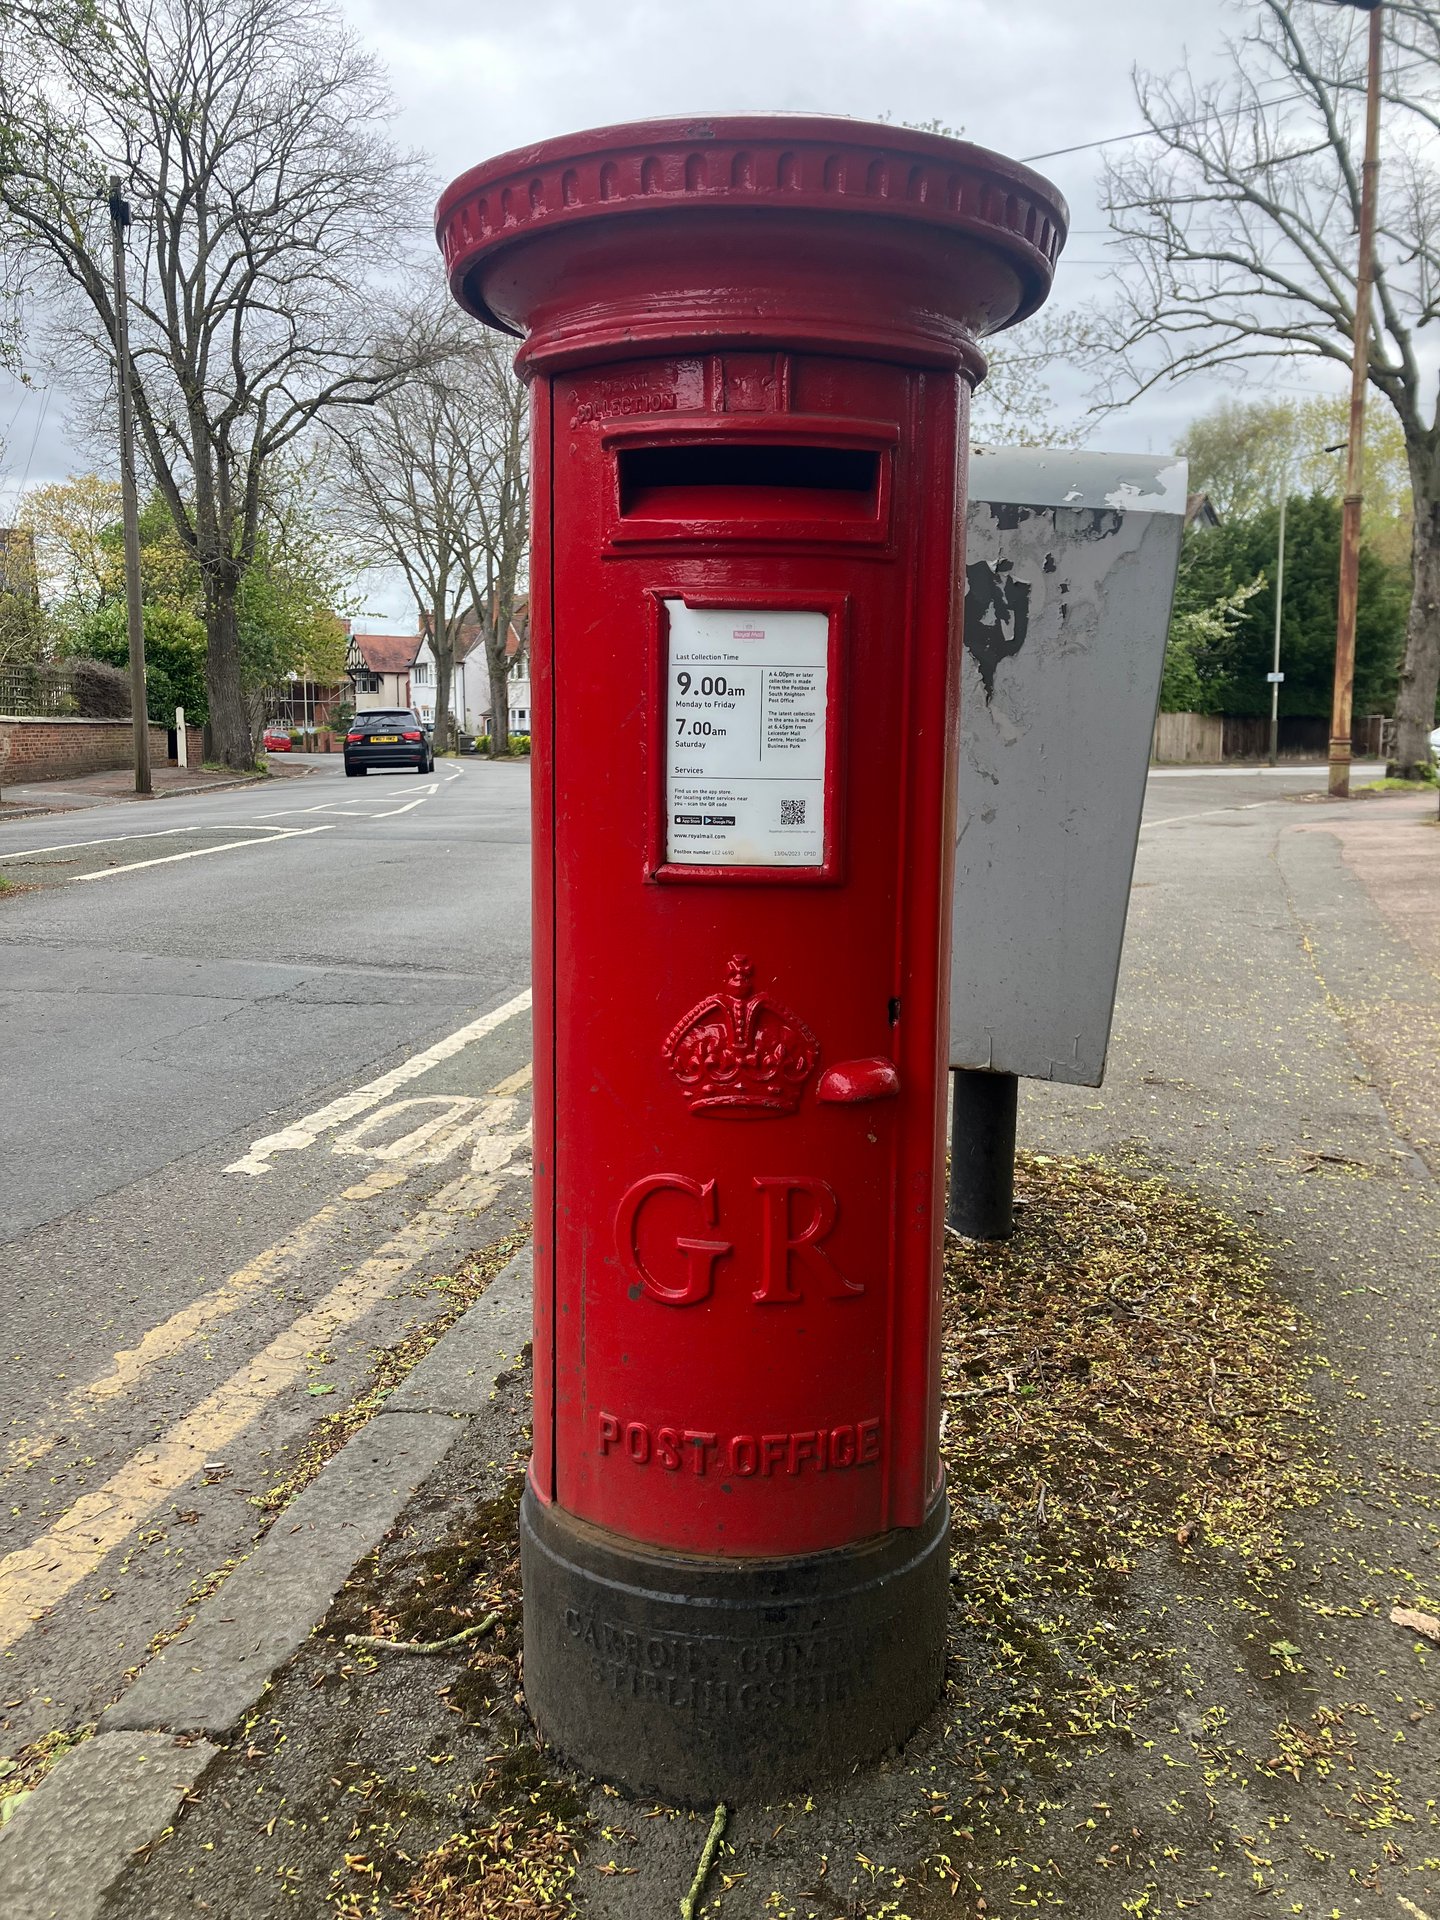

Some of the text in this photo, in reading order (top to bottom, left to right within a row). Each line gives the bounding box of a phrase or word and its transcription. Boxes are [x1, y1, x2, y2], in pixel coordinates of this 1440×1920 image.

[576, 393, 679, 421] COLLECTION
[676, 672, 745, 696] 9.00am
[676, 701, 702, 709] Monday
[676, 719, 726, 736] 7.00am
[675, 741, 706, 749] Saturday
[598, 1411, 881, 1477] POST OFFICE
